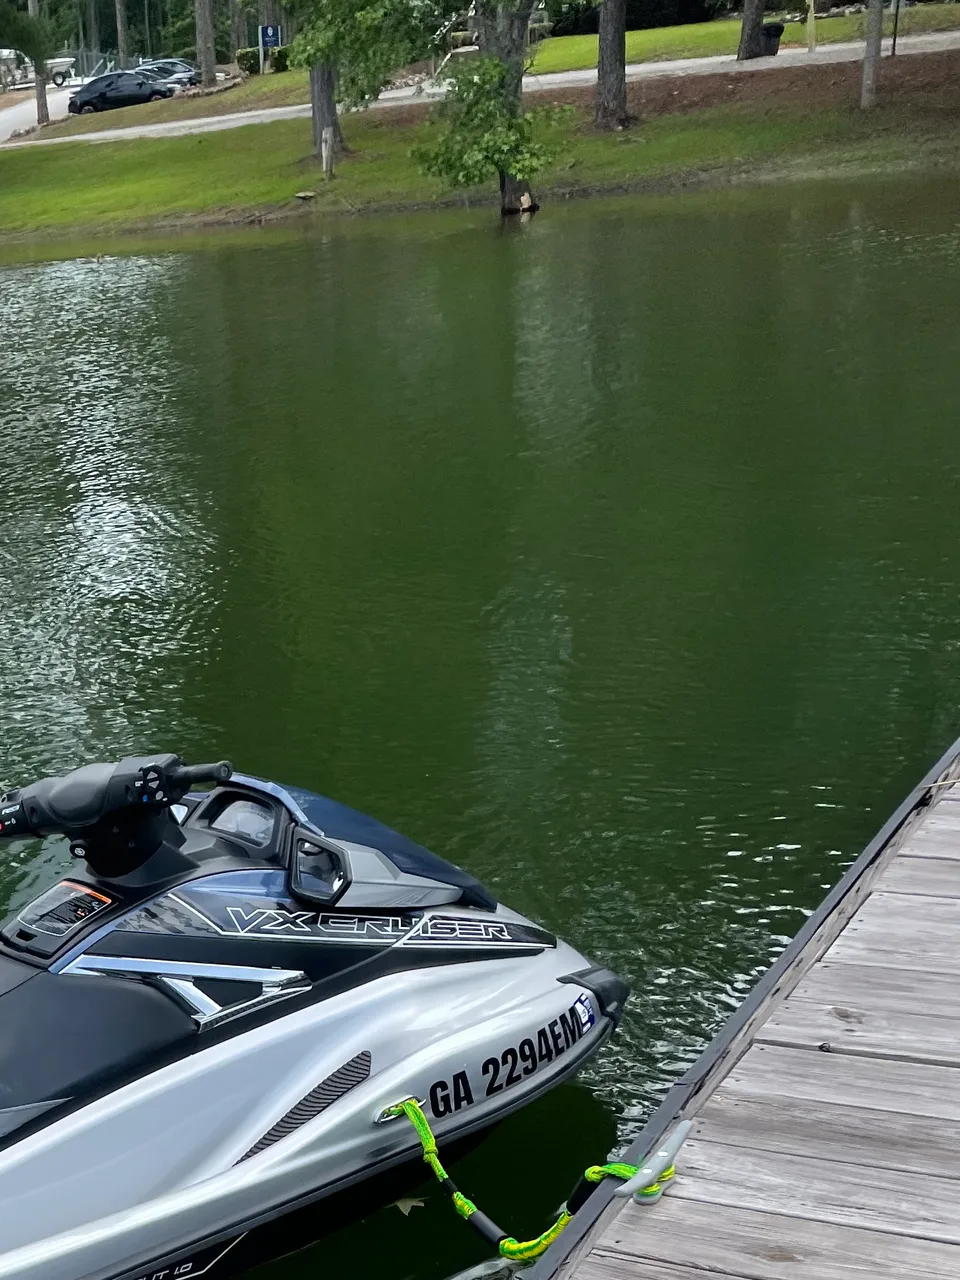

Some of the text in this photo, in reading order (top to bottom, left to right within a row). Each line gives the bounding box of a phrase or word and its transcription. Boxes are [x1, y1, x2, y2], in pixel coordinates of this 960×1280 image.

[226, 907, 512, 939] VX CRUISER
[429, 1070, 474, 1118] GA
[481, 1006, 582, 1097] 2294EM
